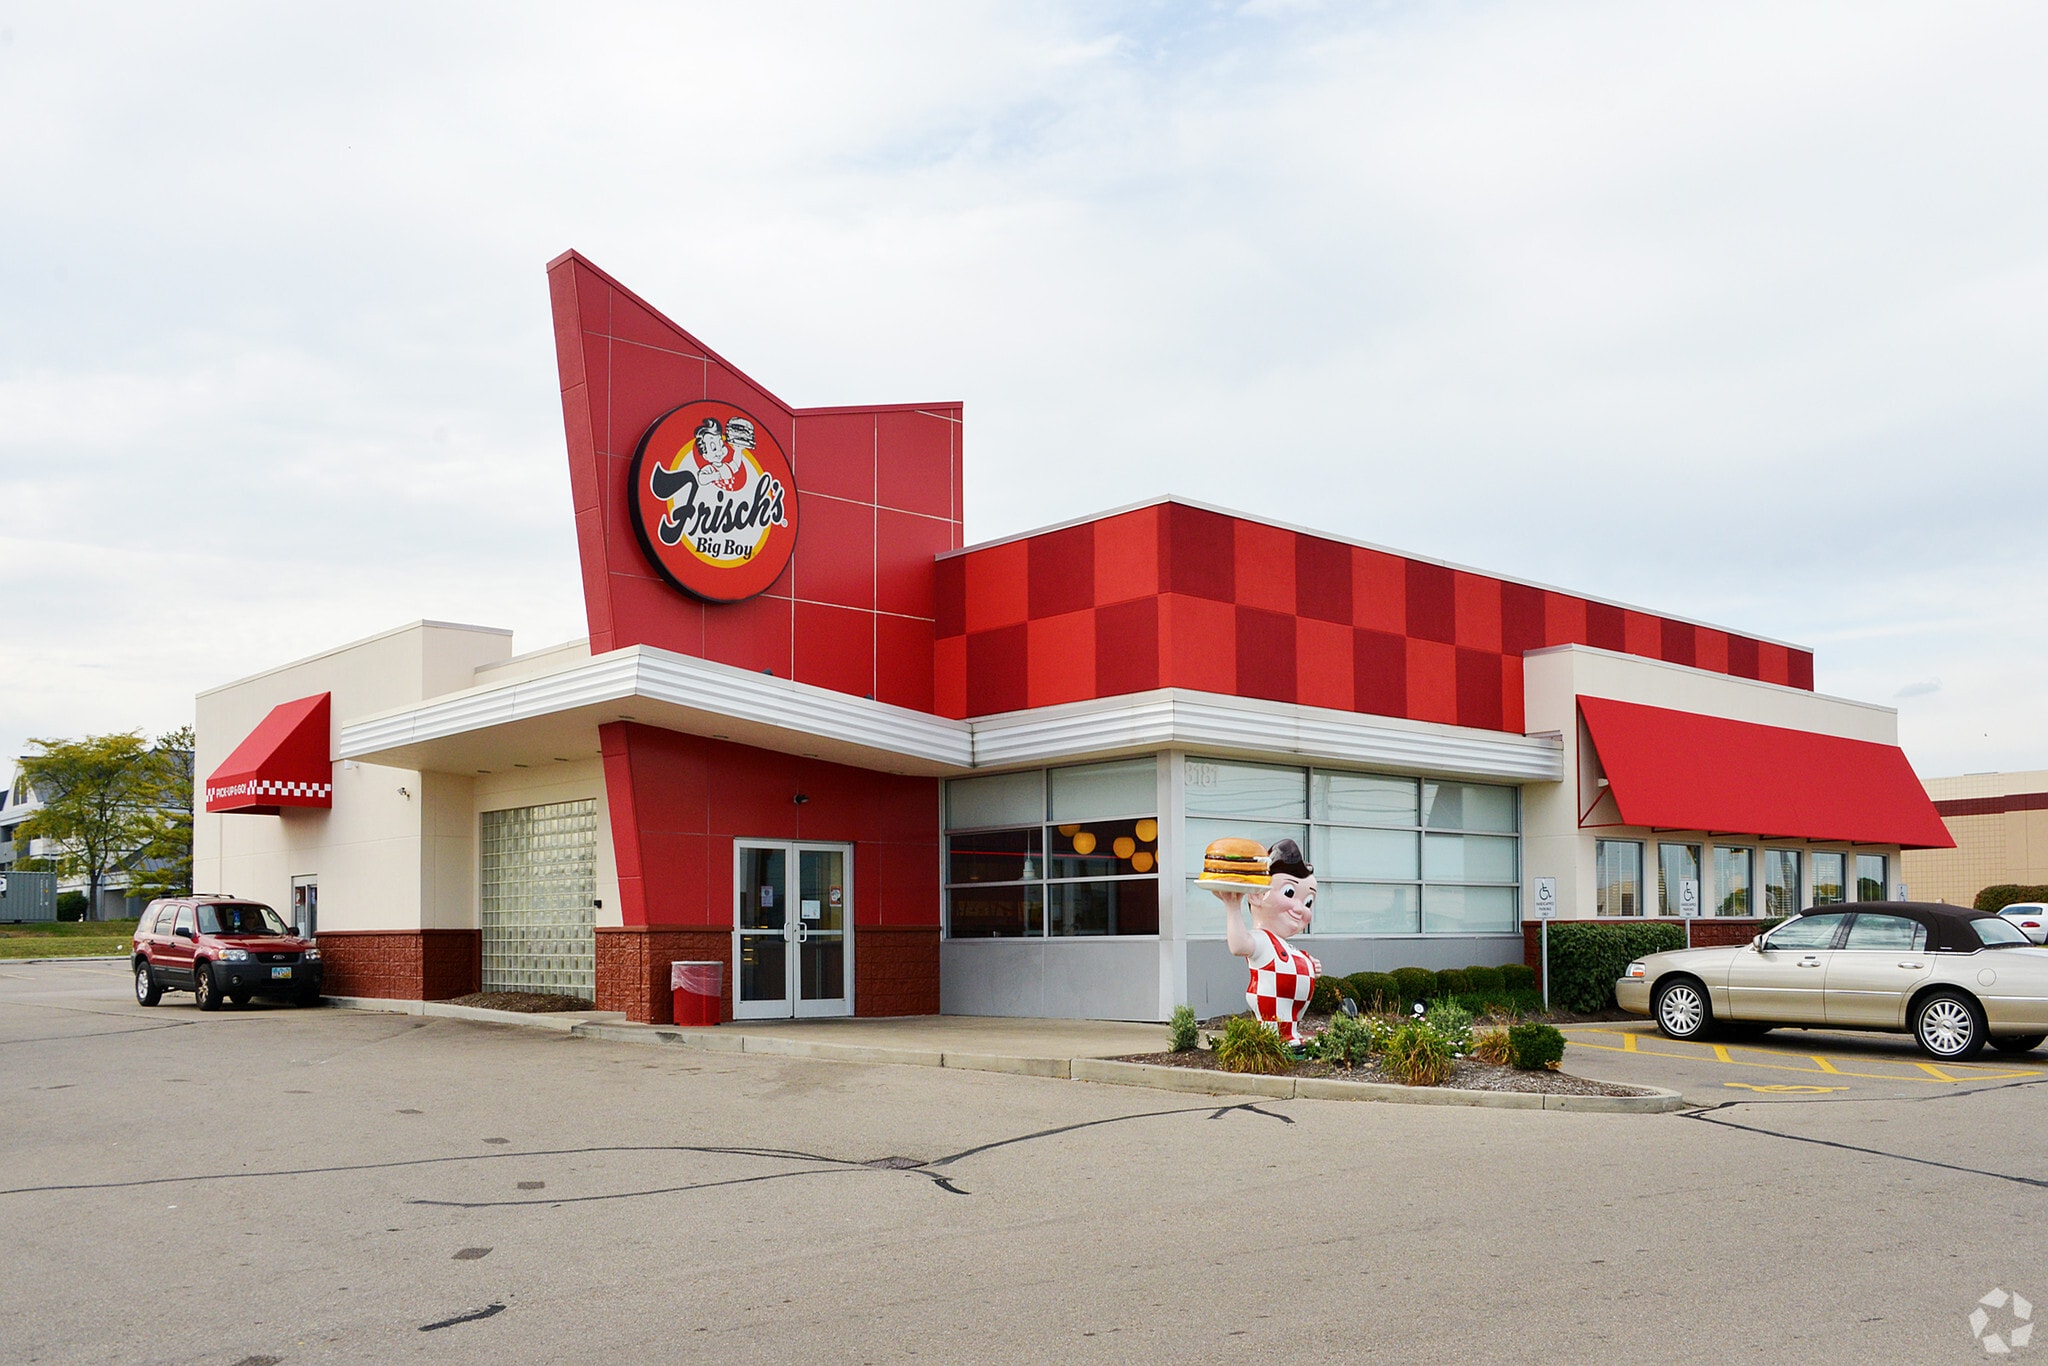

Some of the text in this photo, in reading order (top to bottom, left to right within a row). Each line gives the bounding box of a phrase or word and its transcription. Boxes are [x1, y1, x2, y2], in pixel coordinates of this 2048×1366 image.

[652, 461, 784, 545] Frisch's
[695, 537, 753, 560] Big Boy
